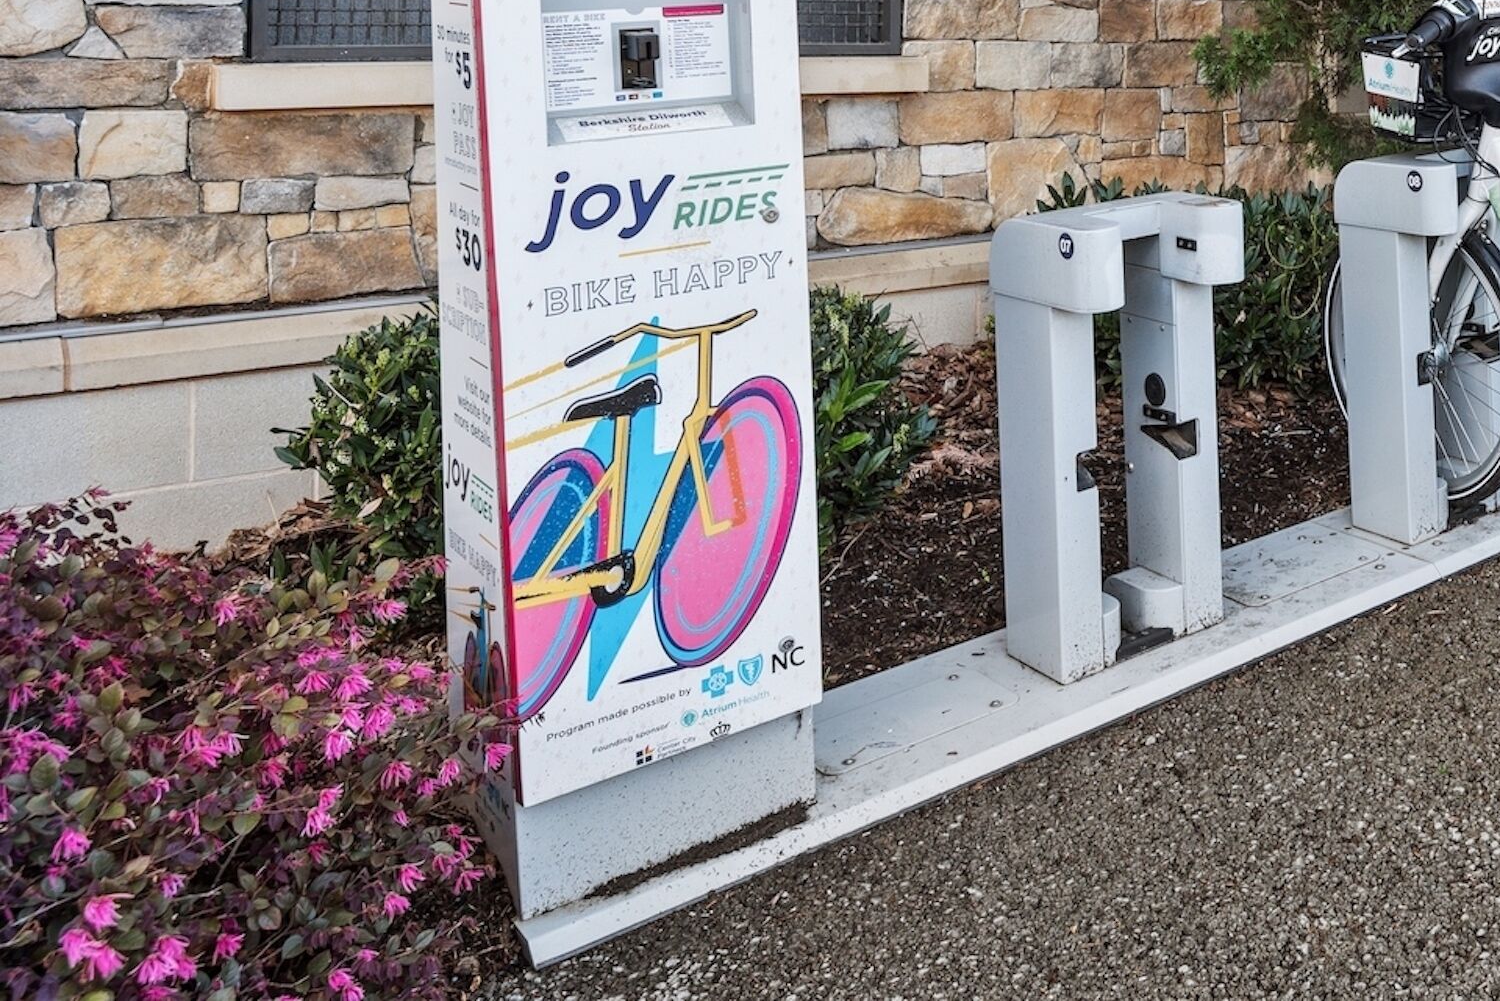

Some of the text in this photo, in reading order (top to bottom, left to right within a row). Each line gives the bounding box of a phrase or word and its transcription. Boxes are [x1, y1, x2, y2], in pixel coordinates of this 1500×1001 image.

[446, 26, 471, 46] minutes
[444, 47, 472, 89] for $5
[578, 109, 707, 127] Berkshire Dilworth
[628, 121, 671, 133] Station
[1407, 174, 1422, 188] 08
[449, 201, 481, 228] All day for
[524, 170, 780, 253] joy RIDES
[455, 226, 482, 272] $30
[1059, 237, 1072, 254] 07
[543, 250, 784, 317] BIKE HAPPY
[445, 442, 470, 502] joy
[470, 490, 493, 524] RIDES
[771, 646, 806, 674] NC
[546, 687, 692, 743] Program made possible by
[701, 689, 770, 719] Atrium Health
[591, 721, 671, 755] Founding sponsor
[682, 735, 696, 746] City
